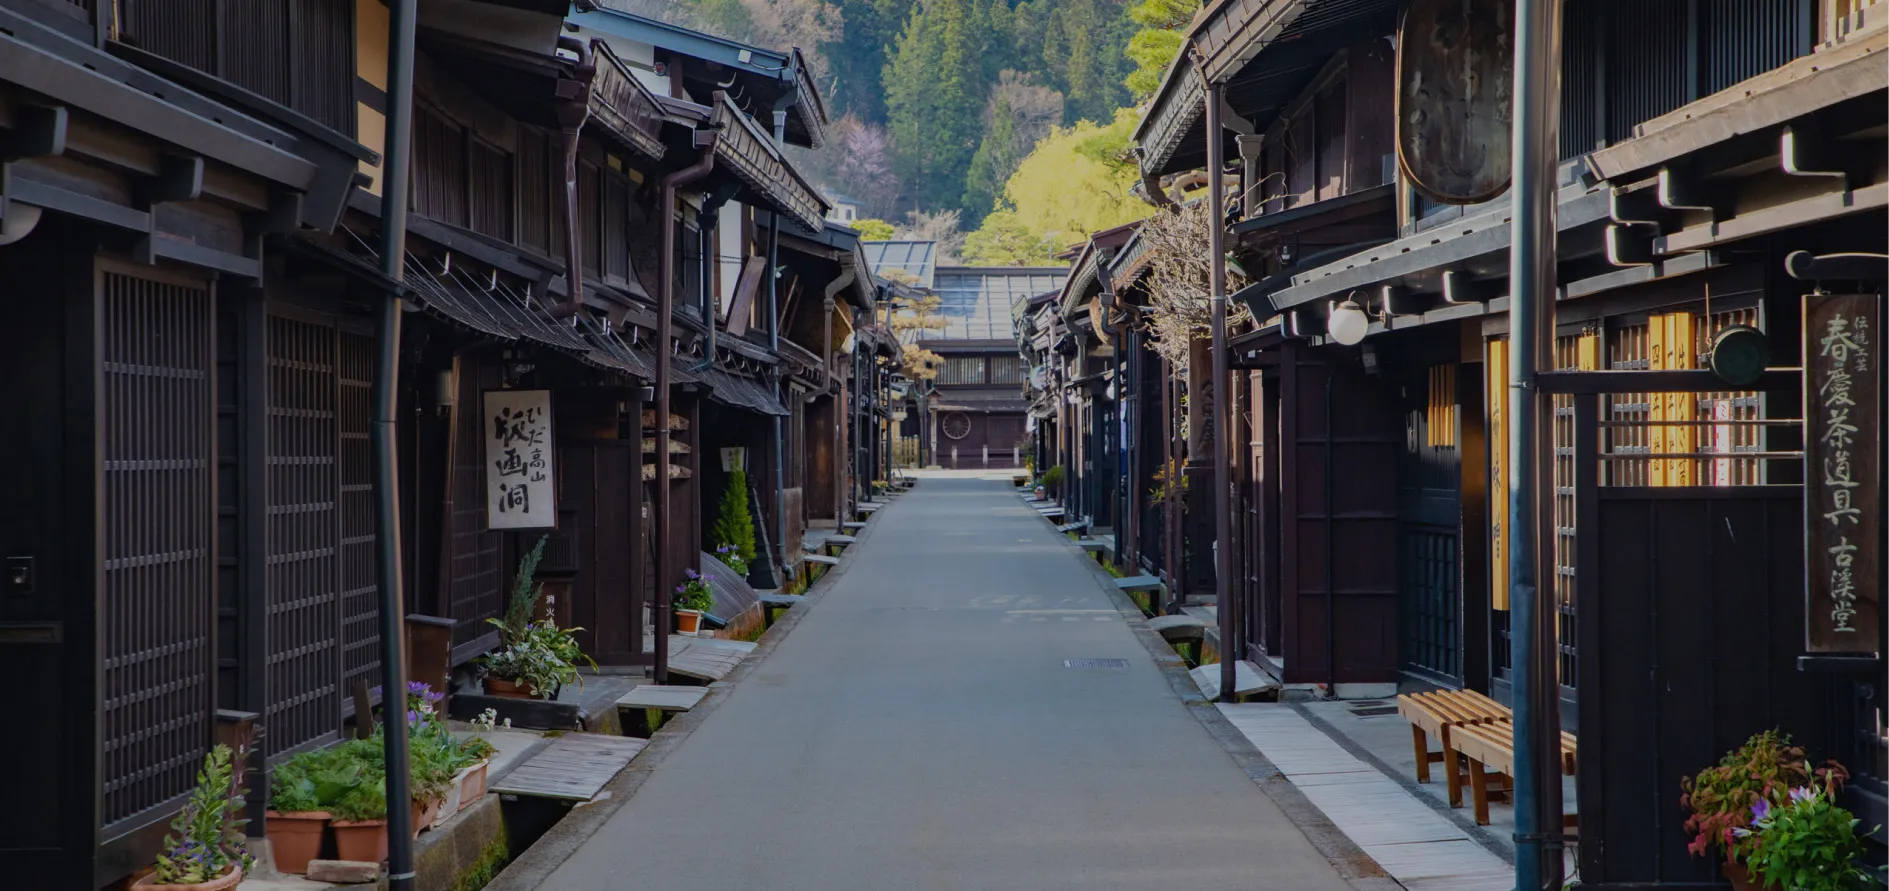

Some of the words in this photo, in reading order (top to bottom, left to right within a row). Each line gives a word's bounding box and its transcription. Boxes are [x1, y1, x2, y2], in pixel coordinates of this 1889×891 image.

[494, 407, 530, 513] 版画洞
[527, 406, 546, 482] ひだ高山
[1820, 314, 1861, 525] 春慶茶道具
